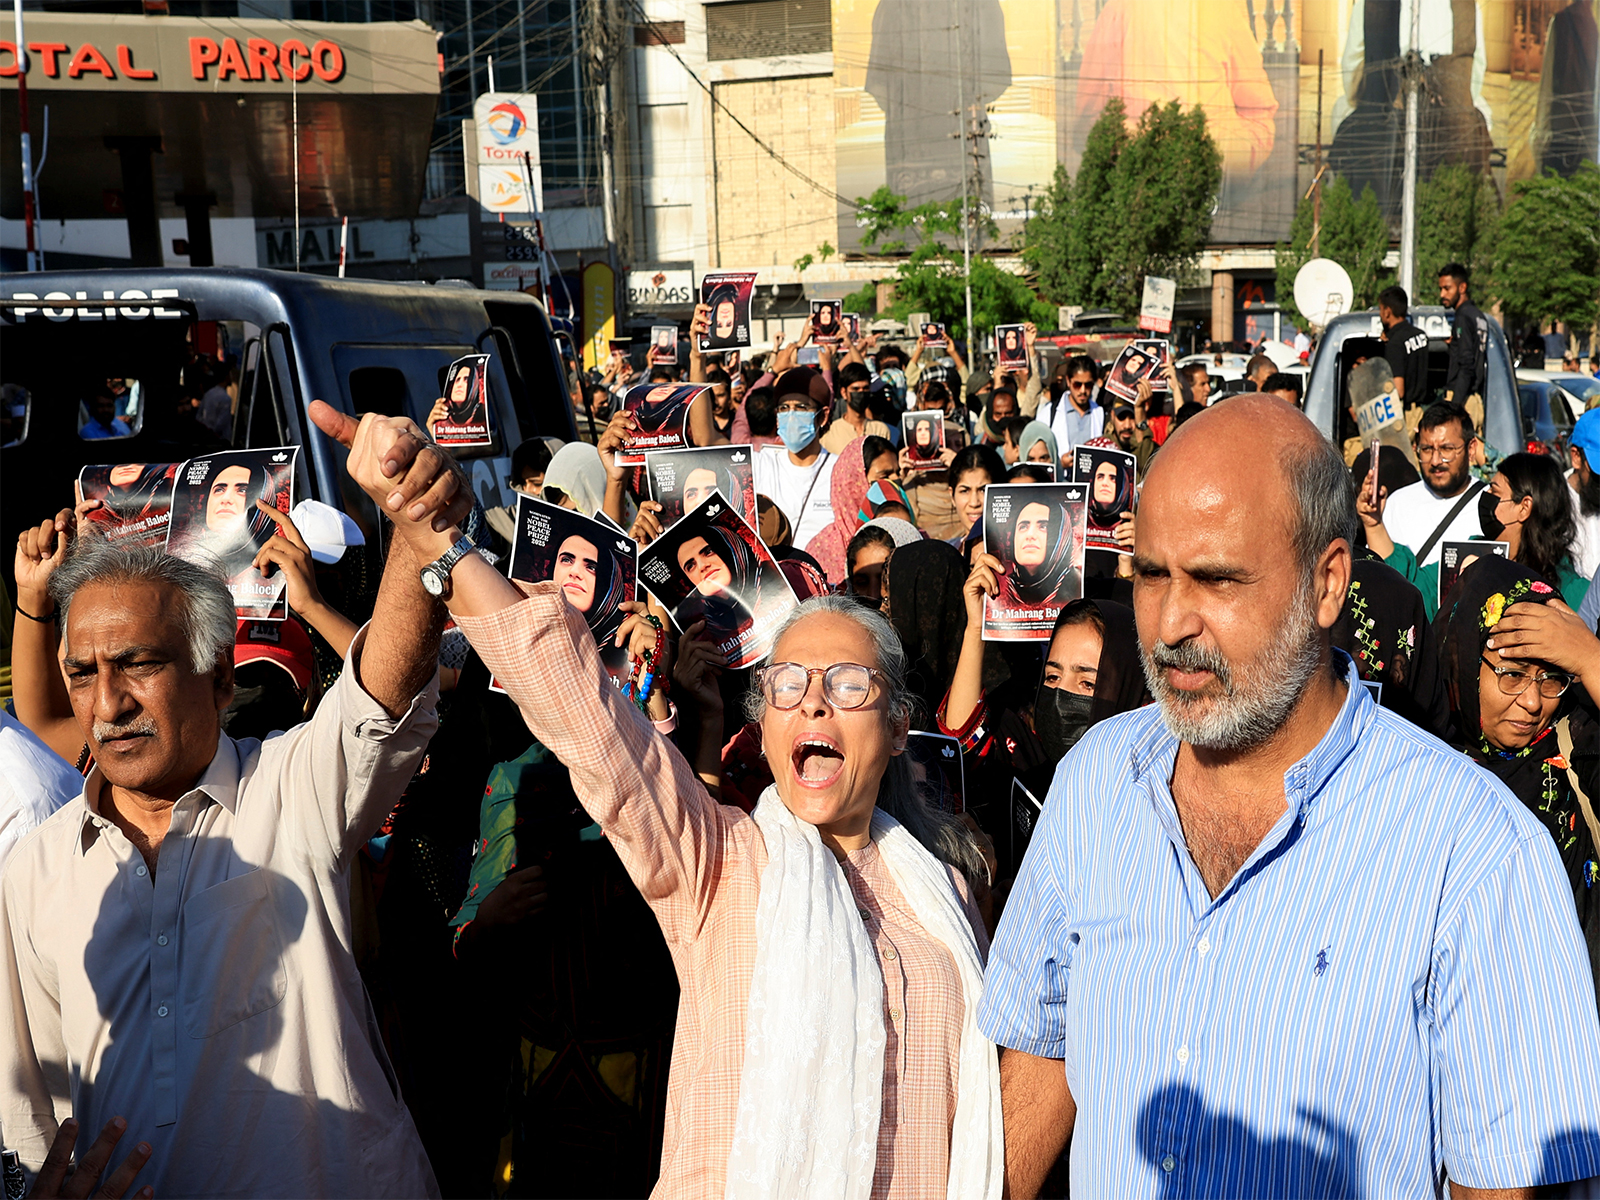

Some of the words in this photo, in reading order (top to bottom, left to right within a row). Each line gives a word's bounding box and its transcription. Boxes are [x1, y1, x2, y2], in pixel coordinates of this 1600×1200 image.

[188, 37, 344, 81] PARCO
[266, 227, 374, 265] MALL
[629, 286, 690, 302] BINDAS
[13, 289, 181, 323] POLICE
[1371, 316, 1453, 337] PICE
[658, 433, 680, 443] Baloch
[527, 517, 552, 530] NOBEL
[527, 524, 551, 536] PEACE
[527, 530, 549, 542] PRIZE
[531, 538, 546, 547] 2025
[241, 582, 279, 595] Baloch
[761, 600, 791, 625] Baloch
[991, 609, 1004, 619] Dr
[1005, 608, 1044, 620] Mahrang
[1045, 607, 1061, 618] Bal
